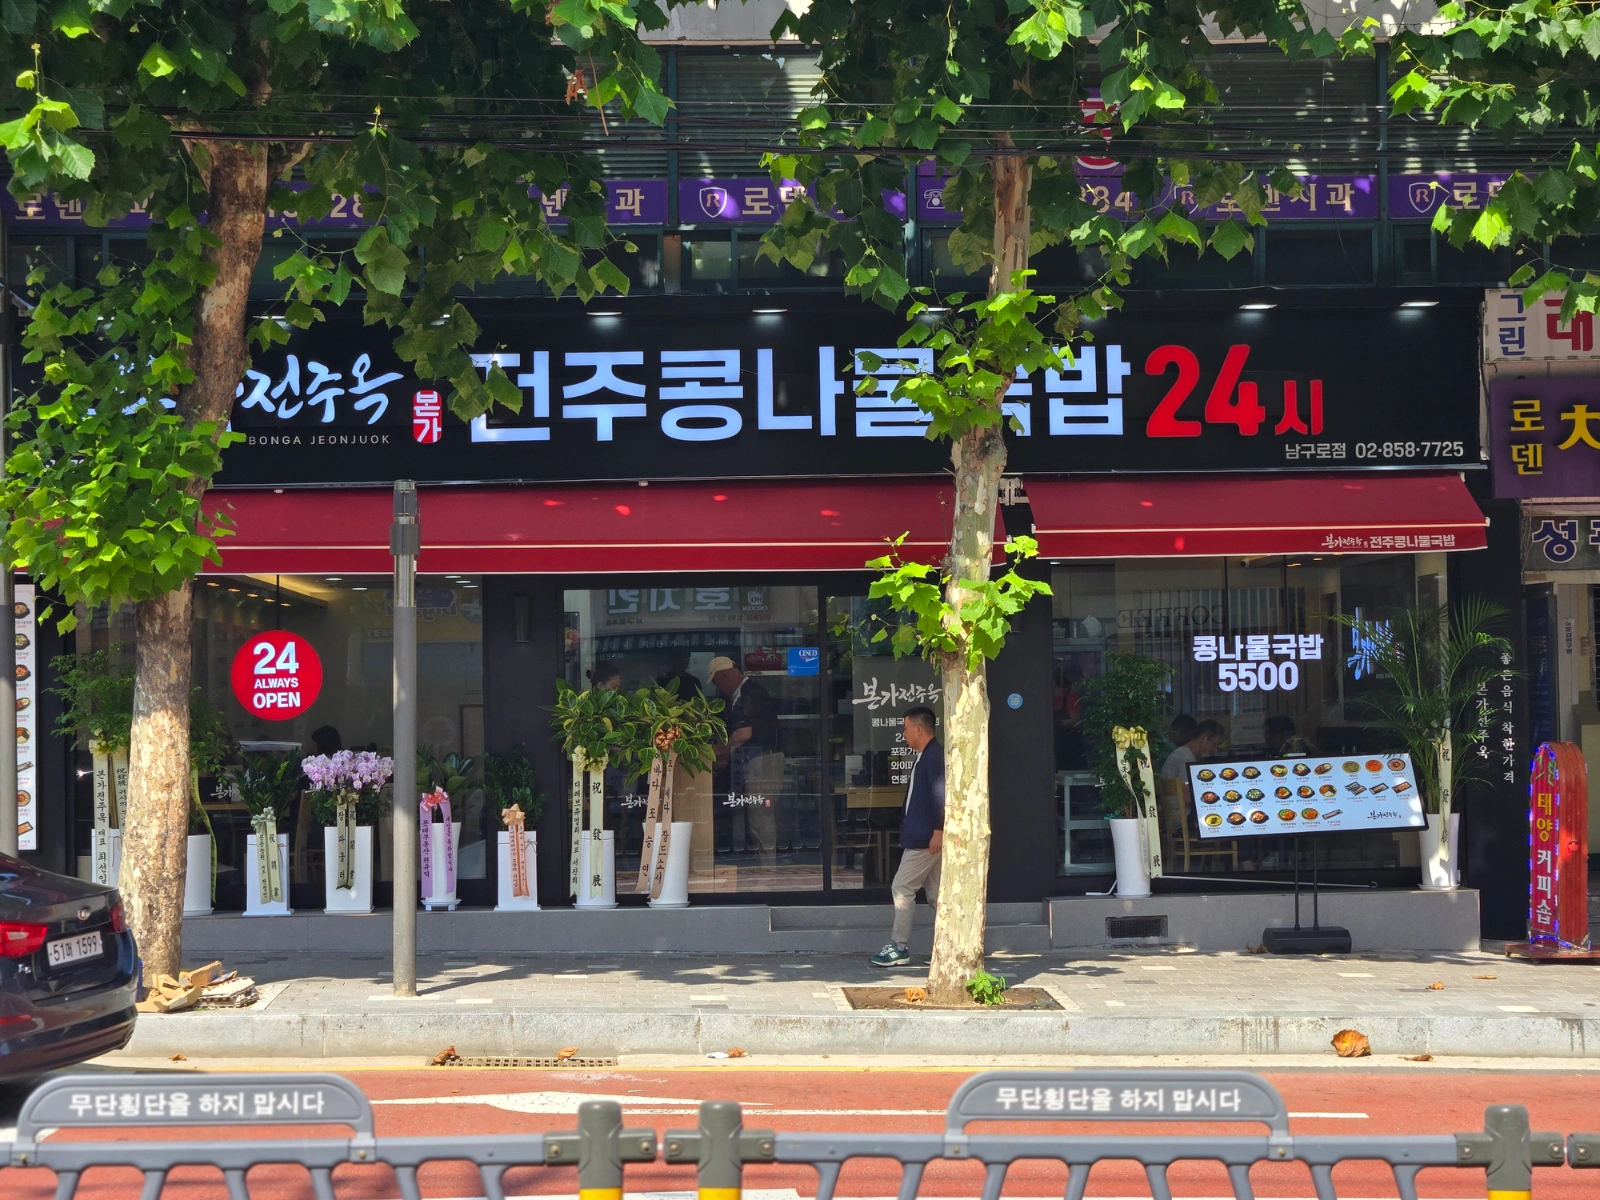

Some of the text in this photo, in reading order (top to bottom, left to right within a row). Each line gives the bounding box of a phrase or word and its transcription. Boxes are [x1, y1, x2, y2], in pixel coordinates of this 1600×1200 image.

[1498, 294, 1527, 356] 그린
[1144, 343, 1325, 438] 24시
[248, 434, 390, 446] BONGA JEONJUOK
[1510, 399, 1545, 476] 로덴
[1285, 443, 1346, 460] 남구로점
[1369, 534, 1456, 549] 전주콩나물국밥
[253, 641, 299, 675] 24
[1192, 634, 1324, 662] 콩나물국밥
[254, 677, 299, 689] ALWAYS
[1218, 661, 1299, 692] 5500
[253, 691, 301, 709] OPEN
[852, 676, 943, 710] 본가전주옥
[1536, 793, 1553, 925] 태양 커피숍
[76, 935, 97, 957] 1599
[68, 1092, 325, 1117] 무단횡단을 하지 맙시다
[995, 1086, 1241, 1112] 무단횡단을 하지 맙시다
